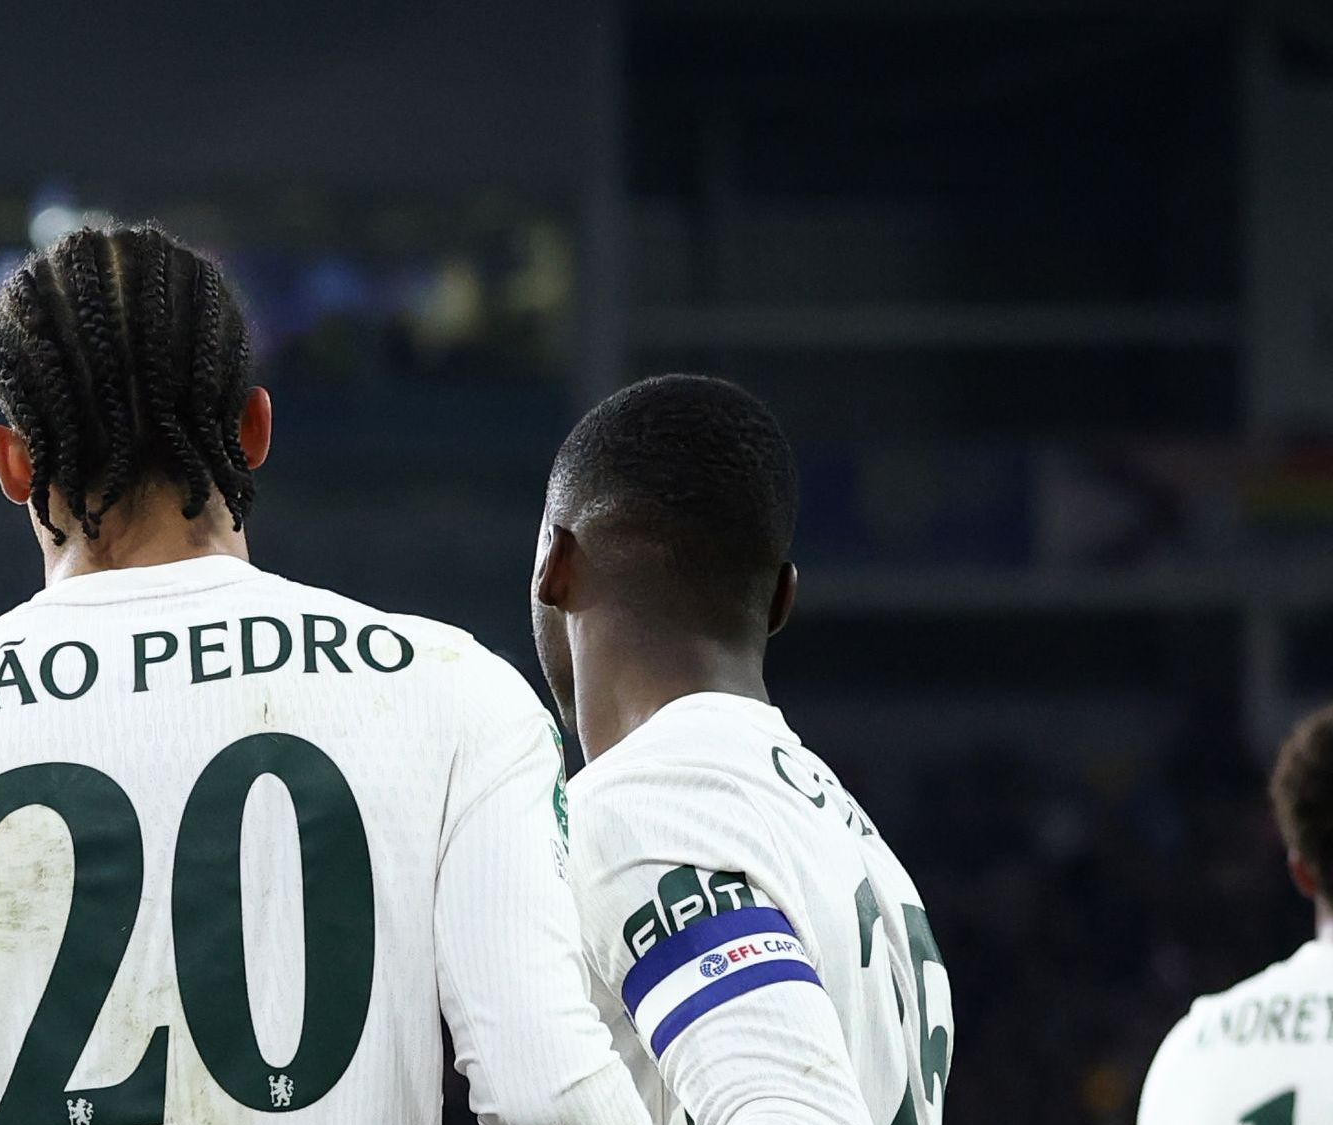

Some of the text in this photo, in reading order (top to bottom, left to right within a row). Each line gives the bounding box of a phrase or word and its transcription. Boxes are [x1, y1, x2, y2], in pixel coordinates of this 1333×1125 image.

[132, 613, 415, 692] PEDRO
[727, 940, 805, 963] EFL CAPT
